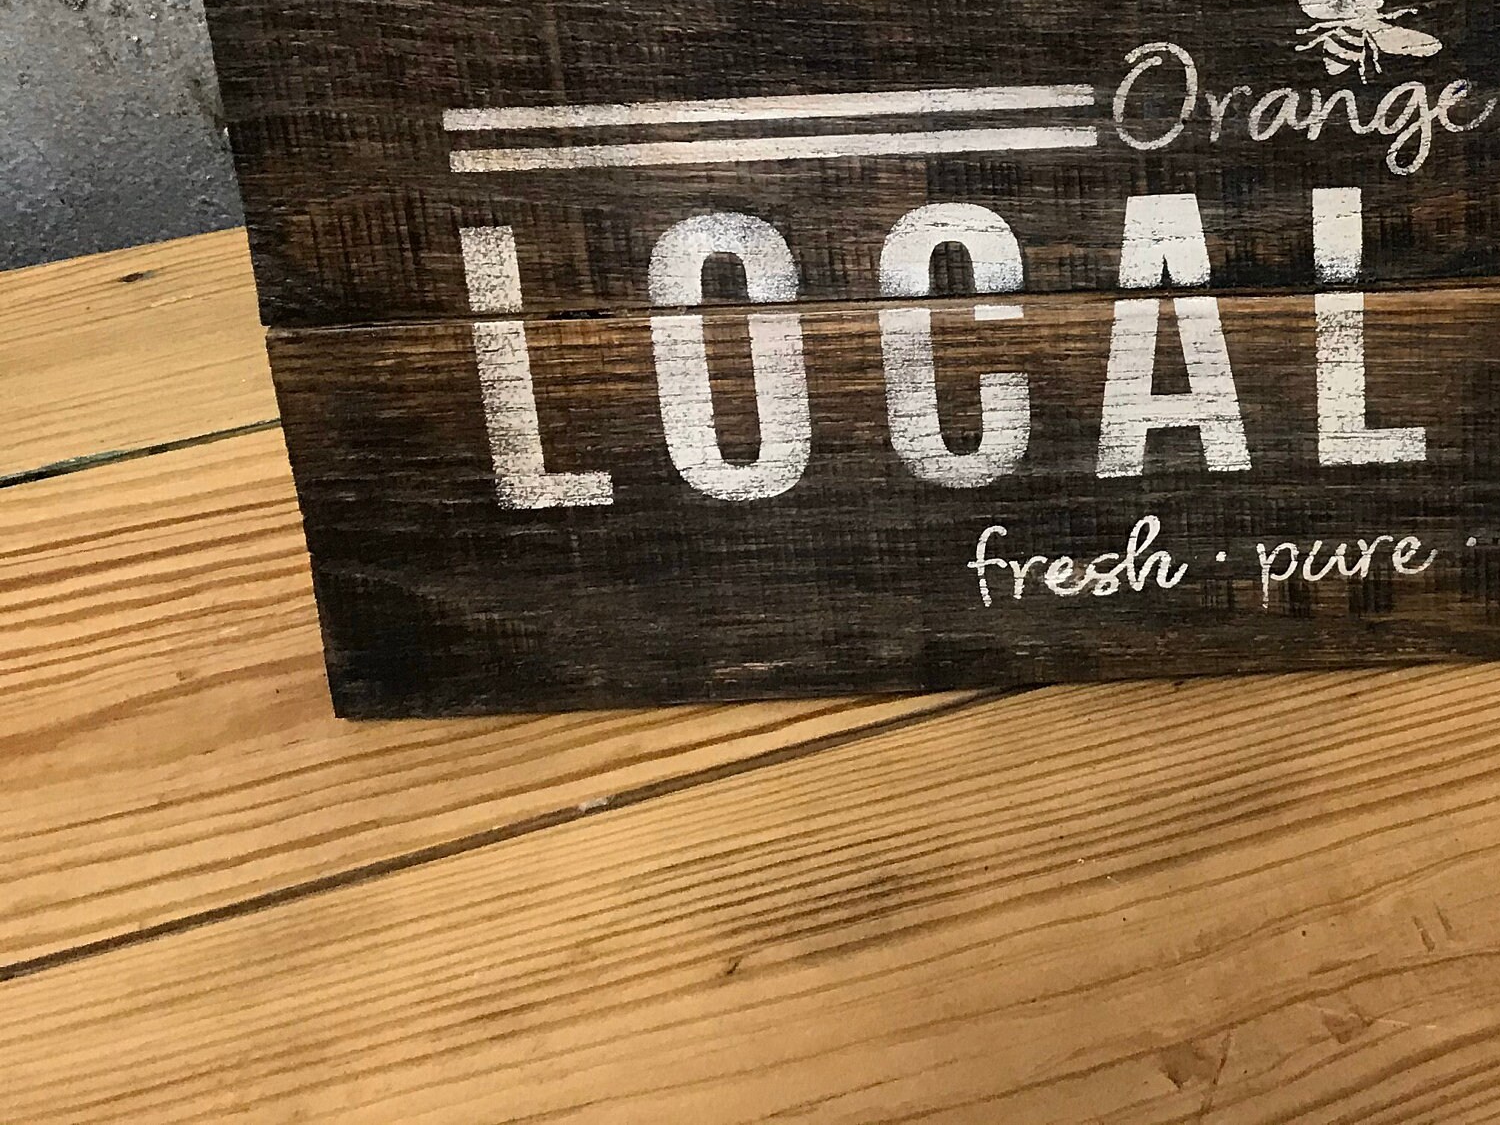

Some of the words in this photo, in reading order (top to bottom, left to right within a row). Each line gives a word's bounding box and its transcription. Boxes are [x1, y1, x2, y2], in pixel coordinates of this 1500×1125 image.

[1112, 40, 1498, 176] Orange
[458, 186, 1428, 511] LOCAL
[967, 514, 1190, 609] fresh
[1256, 530, 1437, 609] pure
